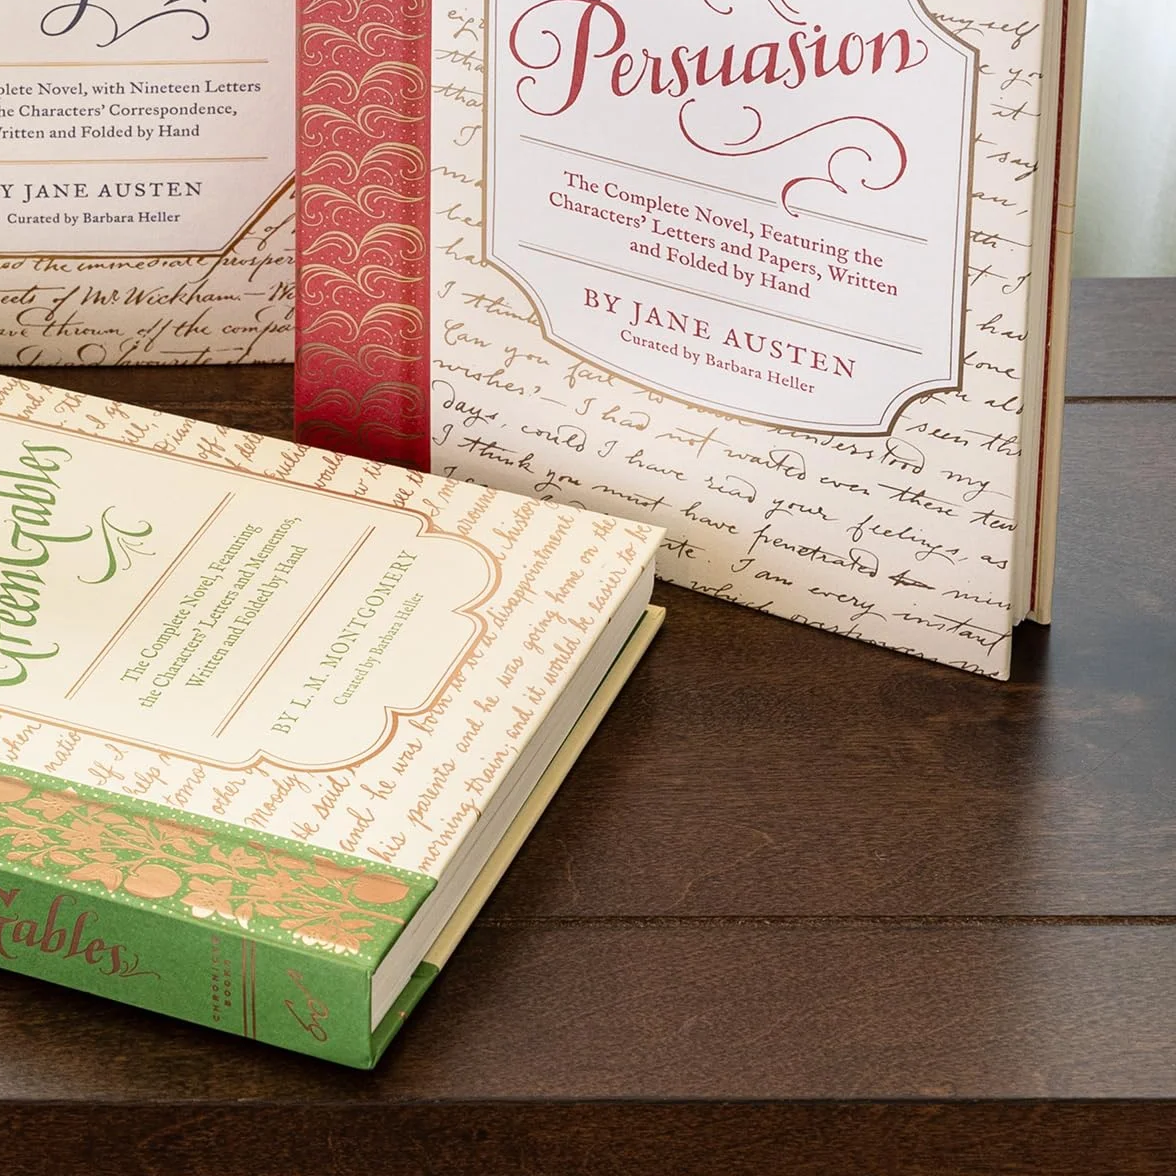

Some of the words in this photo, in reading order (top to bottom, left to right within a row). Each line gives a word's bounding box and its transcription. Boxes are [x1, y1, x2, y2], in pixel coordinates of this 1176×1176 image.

[37, 82, 88, 96] Novel,
[91, 82, 124, 94] with
[129, 81, 200, 94] Nineteen
[204, 79, 261, 92] Letters
[109, 102, 237, 119] Correspondence,
[49, 125, 76, 138] and
[81, 125, 132, 138] Folded
[137, 125, 153, 141] by
[158, 123, 199, 137] Hand
[22, 183, 88, 203] JANE
[97, 181, 202, 197] AUSTEN
[7, 212, 60, 224] Curated
[64, 212, 79, 226] by
[83, 212, 134, 223] Barbara
[138, 211, 180, 222] Heller
[563, 170, 598, 193] The
[604, 182, 689, 217] Complete
[694, 205, 754, 239] Novel,
[759, 222, 849, 264] Featuring
[854, 248, 883, 267] the
[629, 241, 661, 258] and
[666, 246, 728, 276] Folded
[733, 263, 754, 287] by
[760, 271, 810, 298] Hand
[651, 218, 715, 248] Letters
[720, 241, 752, 259] and
[757, 246, 821, 281] Papers,
[827, 264, 897, 296] Written
[584, 287, 621, 314] BY
[629, 300, 710, 339] JANE
[722, 328, 855, 378] AUSTEN
[620, 329, 678, 356] Curated
[682, 345, 700, 365] by
[705, 352, 761, 379] Barbara
[767, 369, 814, 393] Heller
[243, 517, 302, 569] Mementos,
[592, 517, 618, 541] the
[273, 544, 308, 574] Hand
[579, 545, 599, 565] on
[233, 568, 255, 589] and
[261, 574, 288, 588] by
[544, 568, 585, 605] home
[119, 660, 150, 681] The
[140, 608, 191, 658] Complete
[179, 574, 223, 607] Novel,
[207, 523, 263, 572] Featuring
[197, 590, 239, 628] Letters
[233, 588, 274, 626] Folded
[394, 592, 424, 620] Heller
[223, 625, 245, 646] and
[270, 710, 299, 733] BY
[289, 695, 314, 709] L.
[303, 674, 329, 691] M.
[319, 549, 417, 668] MONTGOMERY
[368, 621, 403, 655] Barbara
[524, 609, 567, 655] going
[185, 647, 229, 686] Written
[358, 655, 381, 668] by
[496, 656, 525, 688] was
[138, 689, 162, 707] the
[332, 667, 369, 704] Curated
[473, 695, 500, 714] he
[456, 718, 486, 754] and
[407, 759, 457, 832] parents
[367, 832, 407, 864] his
